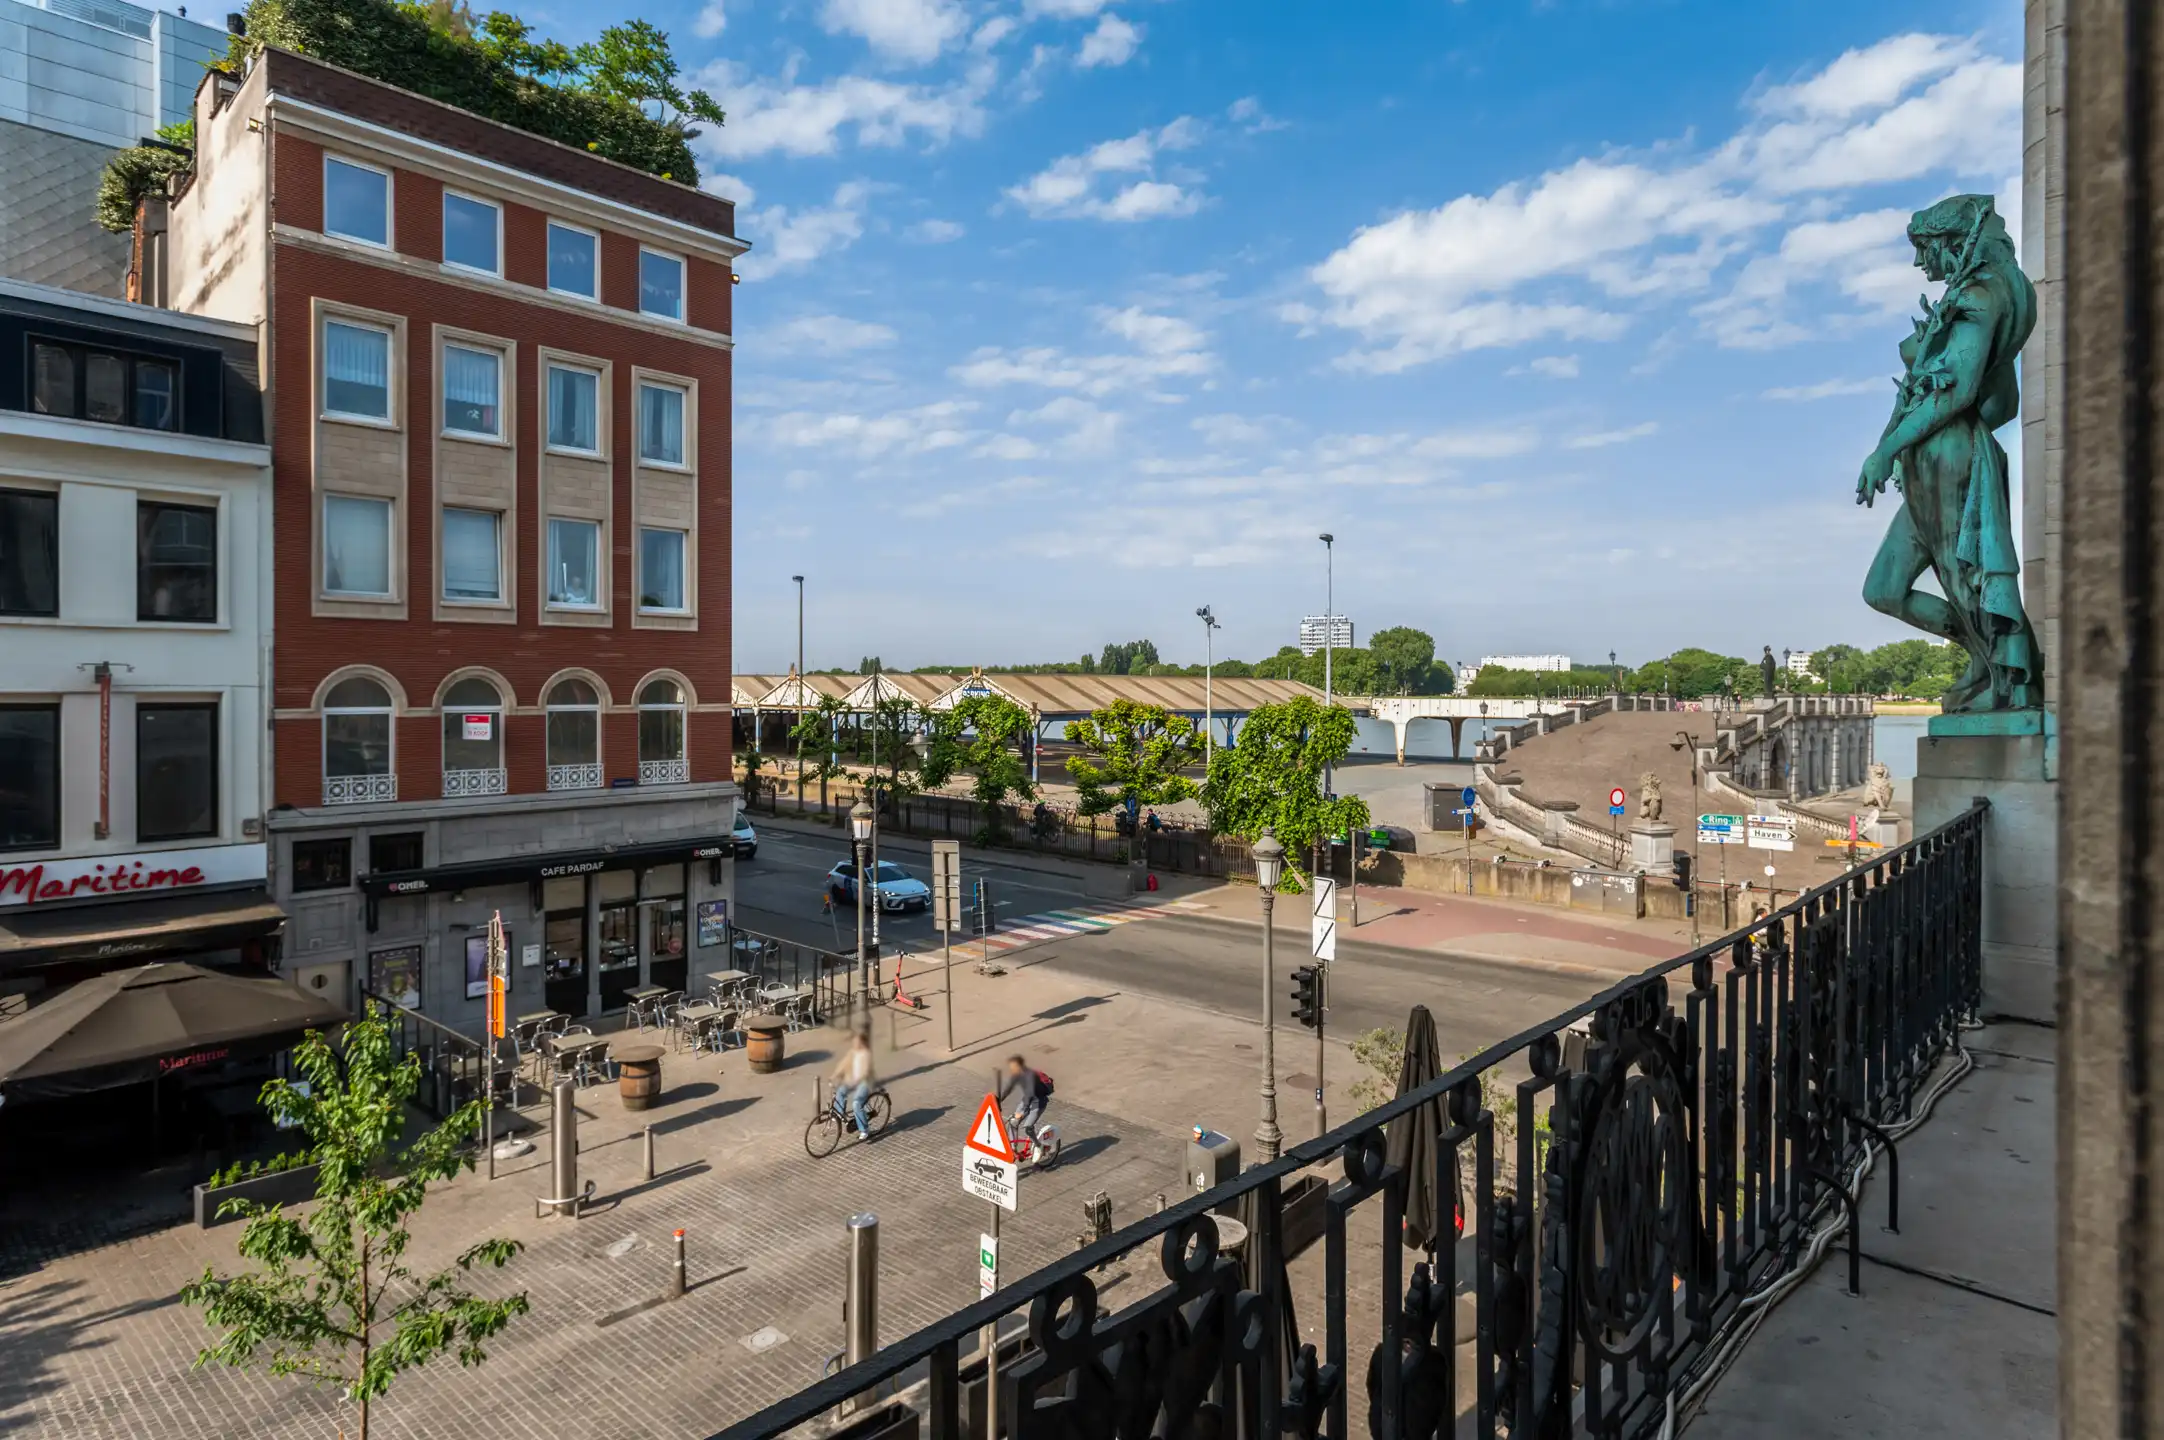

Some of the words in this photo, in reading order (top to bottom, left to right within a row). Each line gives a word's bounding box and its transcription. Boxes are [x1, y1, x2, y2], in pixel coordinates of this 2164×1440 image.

[1708, 816, 1728, 826] Ring
[1754, 829, 1783, 839] Haven
[541, 866, 566, 877] CAFE
[567, 861, 604, 874] PARDAF
[0, 861, 205, 905] Maritime
[969, 1173, 1009, 1197] BEWEEGBAAR
[974, 1186, 1003, 1205] OBSTAKEL
